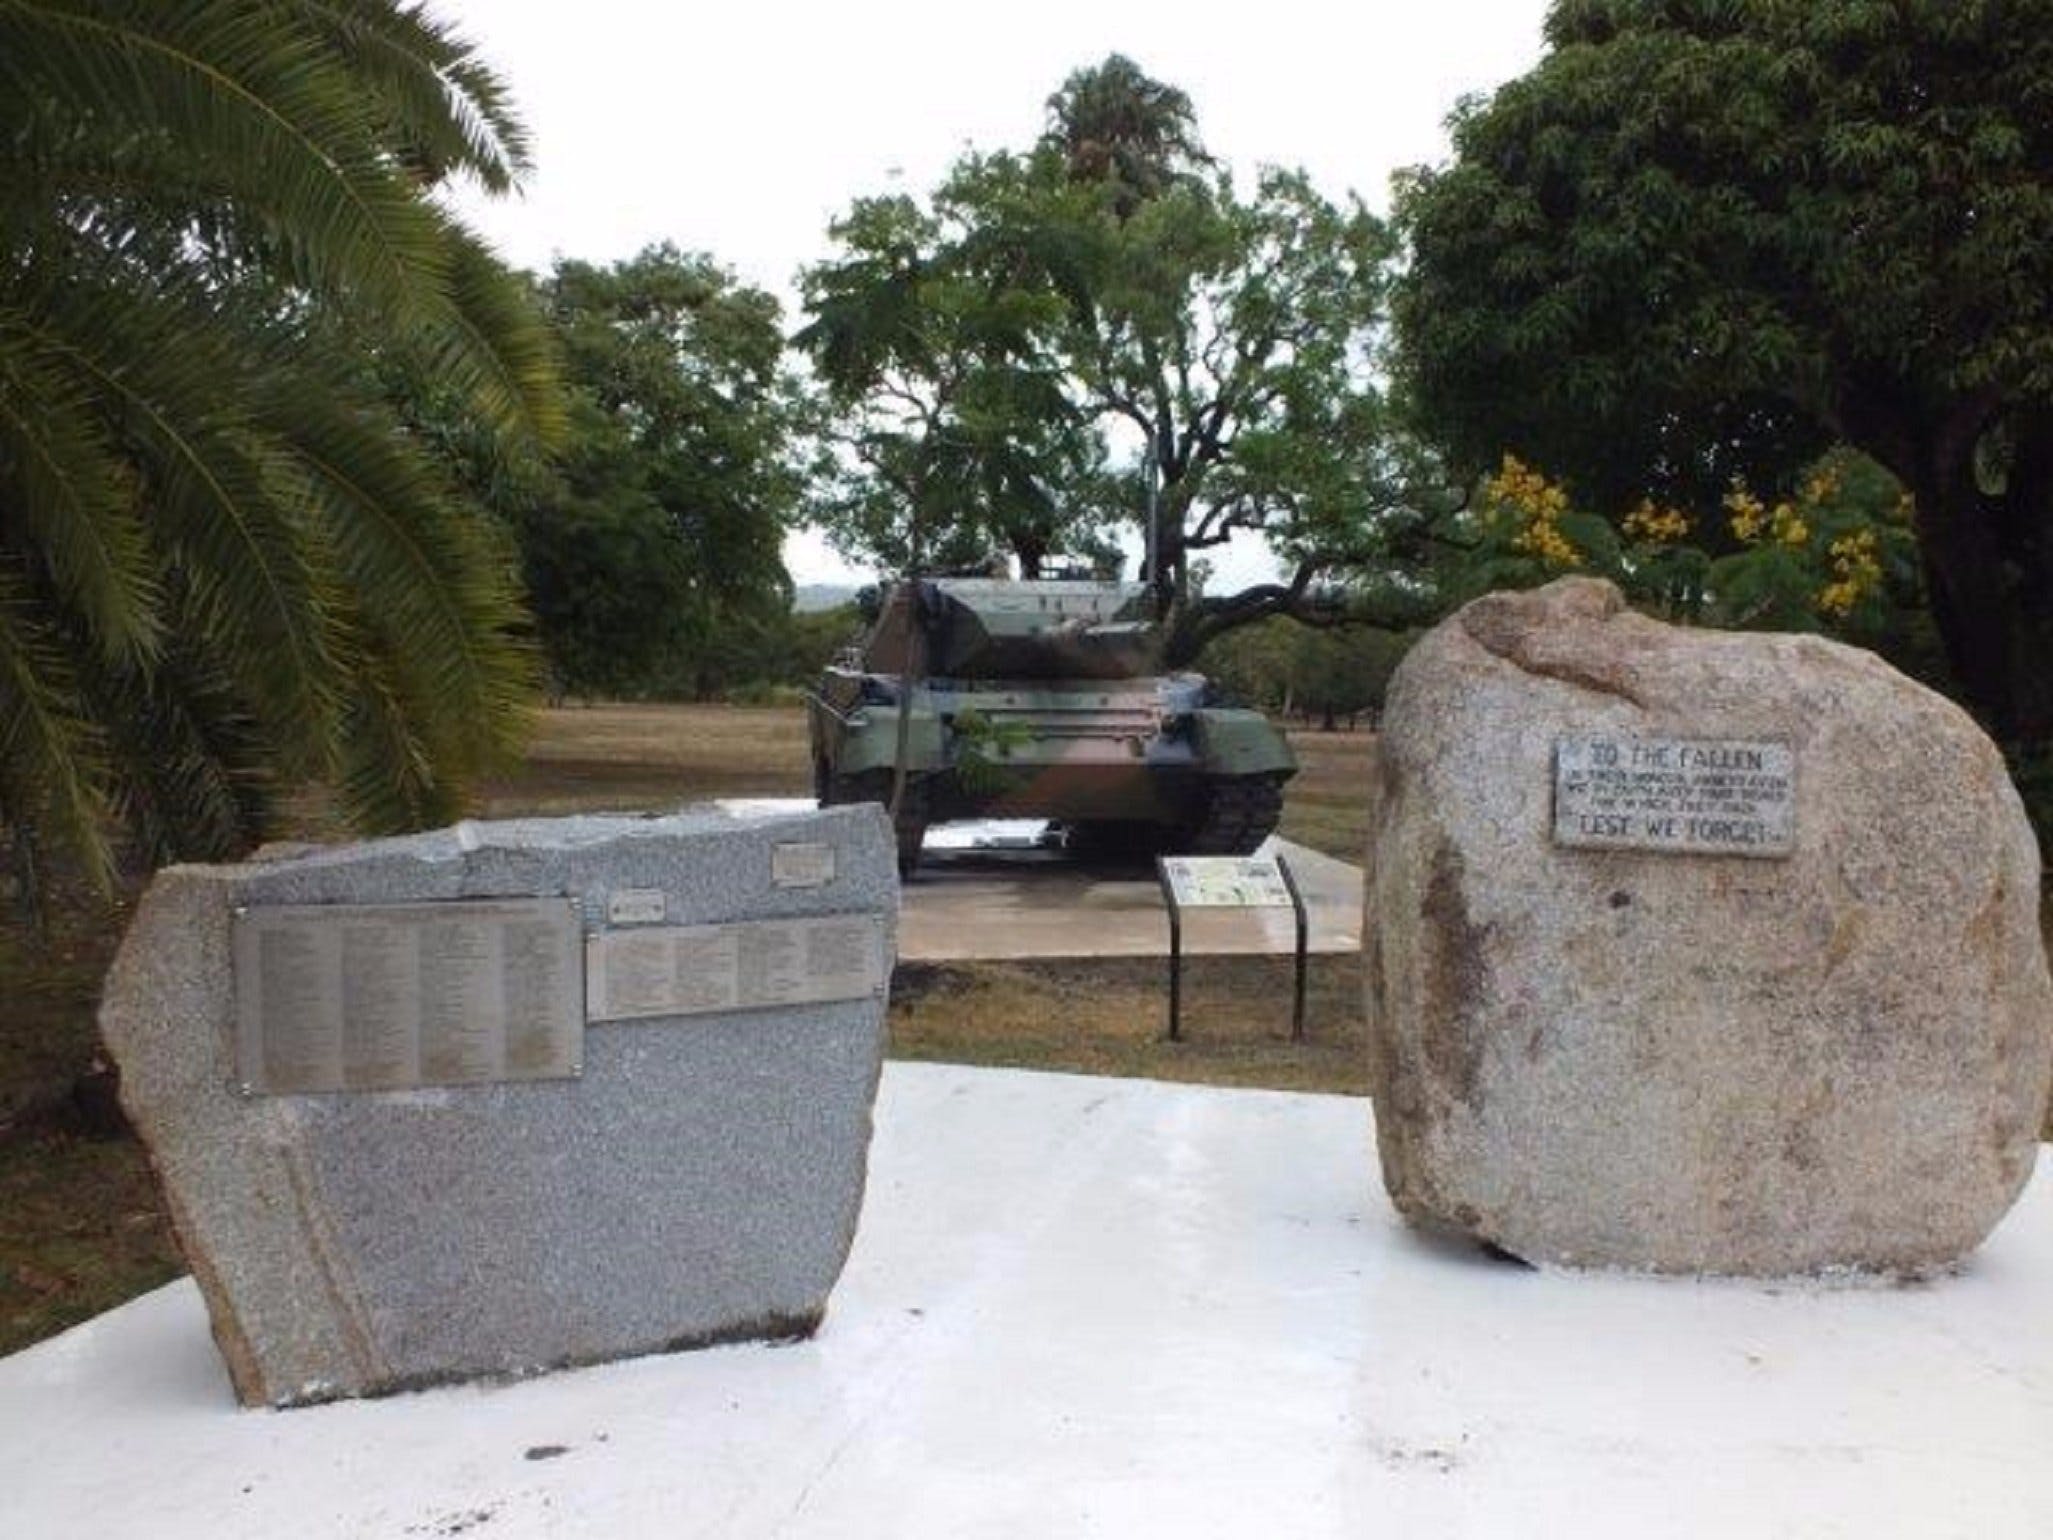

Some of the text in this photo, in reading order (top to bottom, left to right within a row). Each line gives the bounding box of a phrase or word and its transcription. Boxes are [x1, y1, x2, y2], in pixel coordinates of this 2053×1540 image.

[1632, 743, 1670, 767] THE
[1680, 748, 1762, 769] FALLEN
[1580, 814, 1765, 844] LEST WE FORGET
